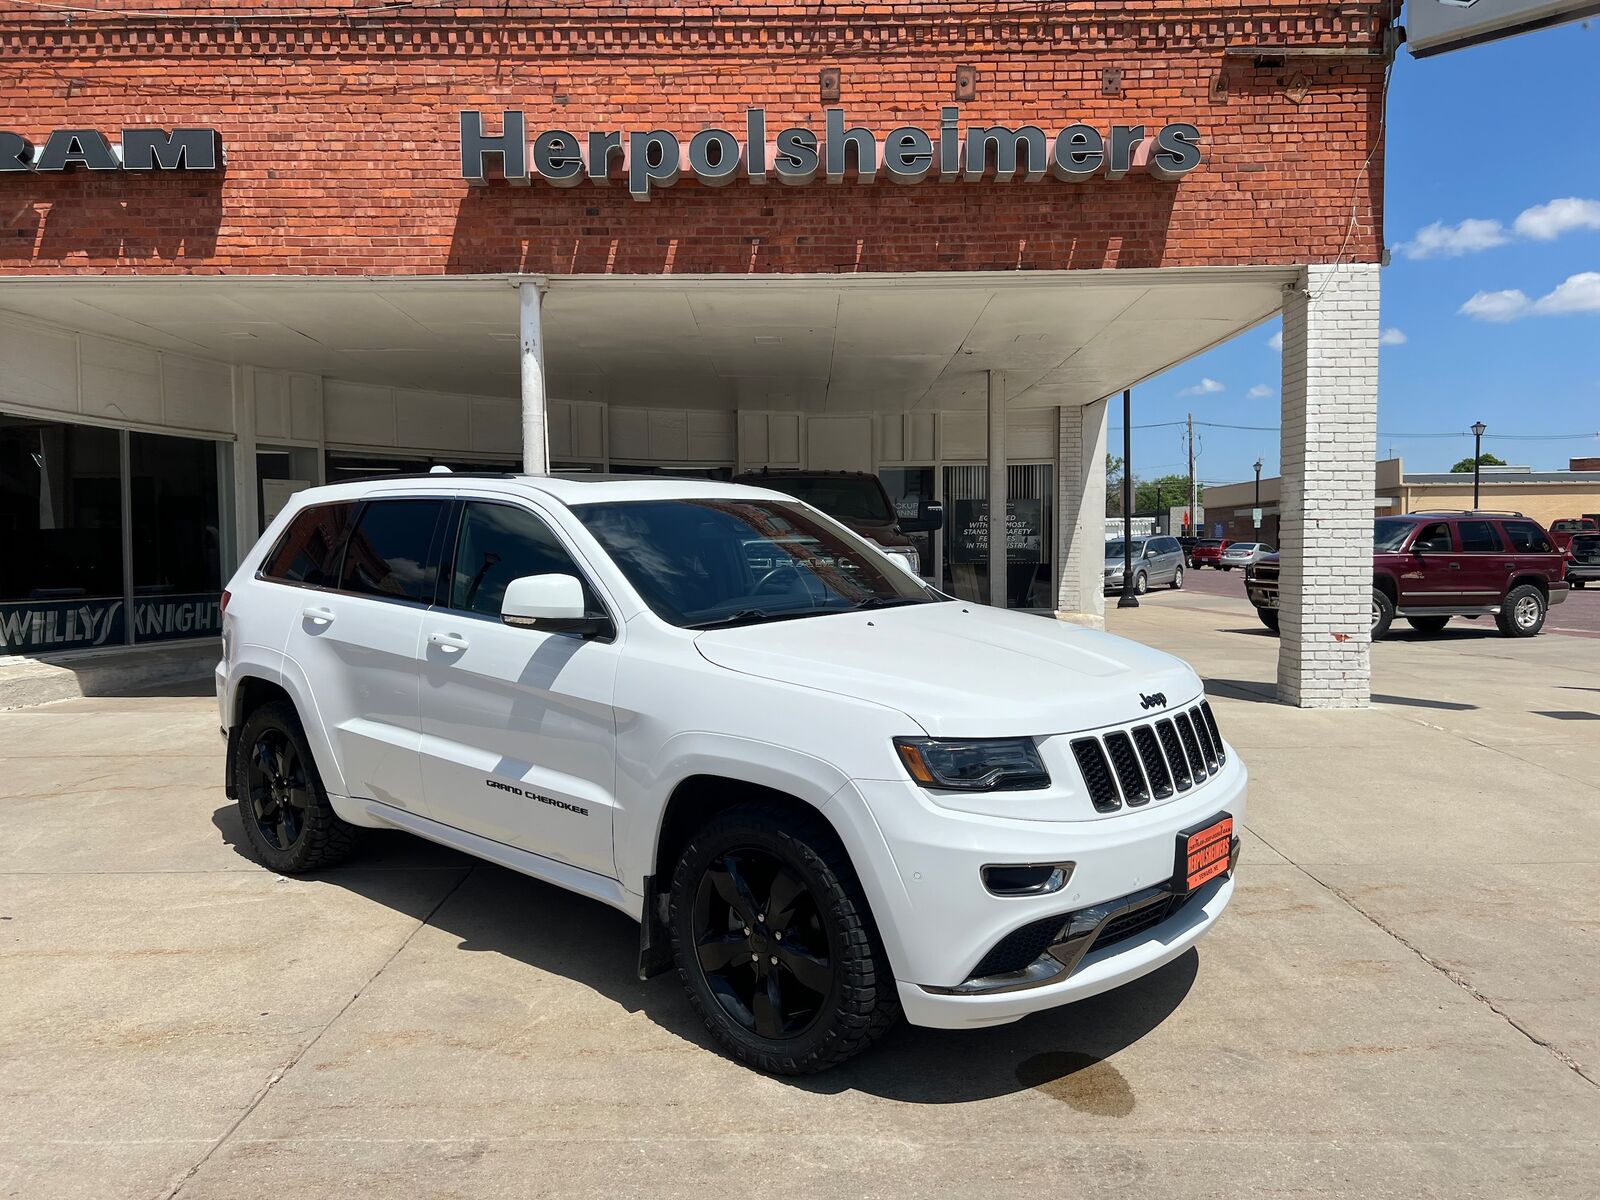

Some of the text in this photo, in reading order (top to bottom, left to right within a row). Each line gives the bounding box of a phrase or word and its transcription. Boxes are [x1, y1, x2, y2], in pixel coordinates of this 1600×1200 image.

[459, 106, 1201, 199] Herpolsheimers
[0, 601, 123, 647] WILLYS
[1139, 692, 1167, 710] Jeep
[485, 779, 589, 816] GRAND CHEROKEE
